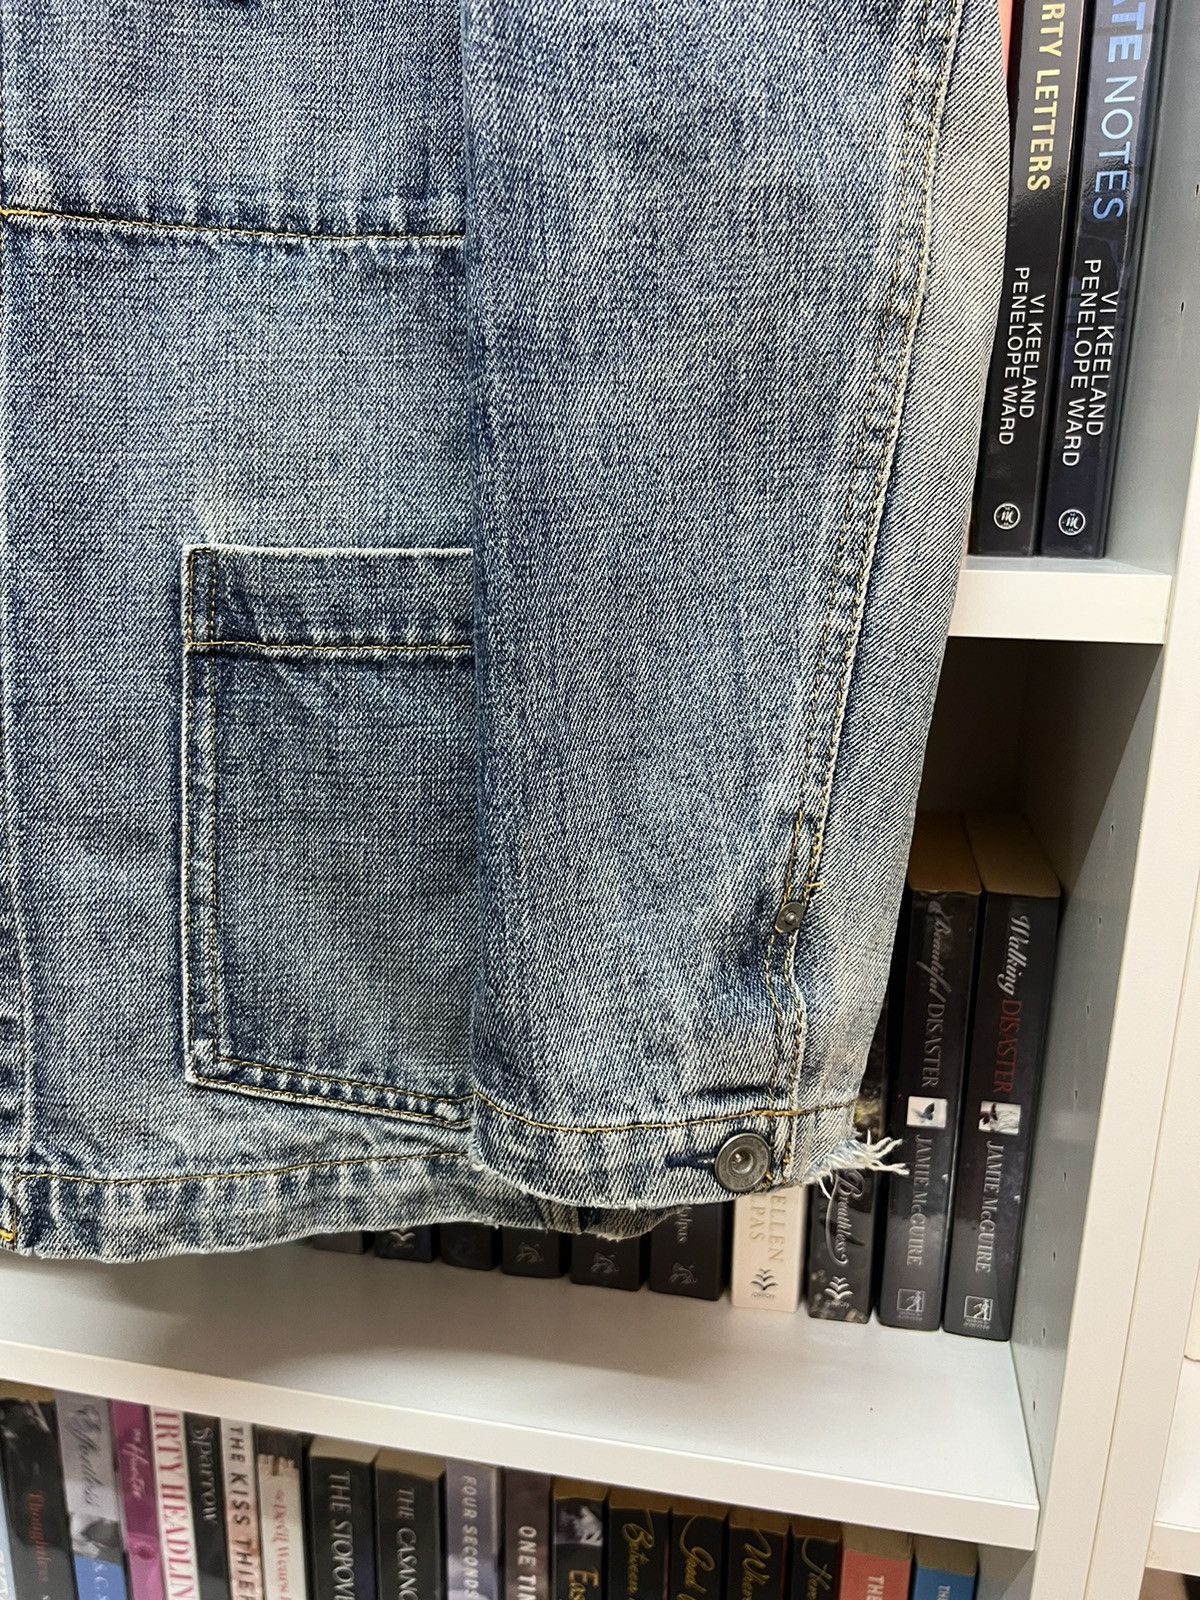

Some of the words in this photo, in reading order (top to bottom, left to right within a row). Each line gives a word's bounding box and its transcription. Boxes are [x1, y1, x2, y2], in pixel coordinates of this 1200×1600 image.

[1027, 69, 1061, 192] LETTERS
[1092, 75, 1139, 220] NOTES
[1004, 266, 1030, 379] PENELOPE
[1028, 294, 1046, 315] VI
[1070, 259, 1102, 389] PENELOPE
[1100, 290, 1120, 313] VI
[1019, 321, 1044, 418] KEELAND
[1086, 325, 1115, 436] KEELAND
[998, 385, 1019, 445] WARD
[1062, 397, 1086, 467] WARD
[997, 914, 1031, 996] Walking
[922, 1002, 946, 1088] DISASTER
[992, 999, 1024, 1094] DISASTER
[913, 1134, 933, 1188] JAMIE
[983, 1140, 1004, 1194] JAMIE
[767, 1195, 787, 1263] ELLEN
[825, 1168, 865, 1265] Breathless
[190, 1426, 219, 1525] Sparrow
[229, 1426, 246, 1464] THE
[230, 1472, 251, 1525] KISS
[328, 1470, 352, 1515] THE
[396, 1487, 415, 1521] THE
[462, 1475, 479, 1519] FOUR
[462, 1524, 480, 1600] SECONDS
[517, 1525, 538, 1568] ONE
